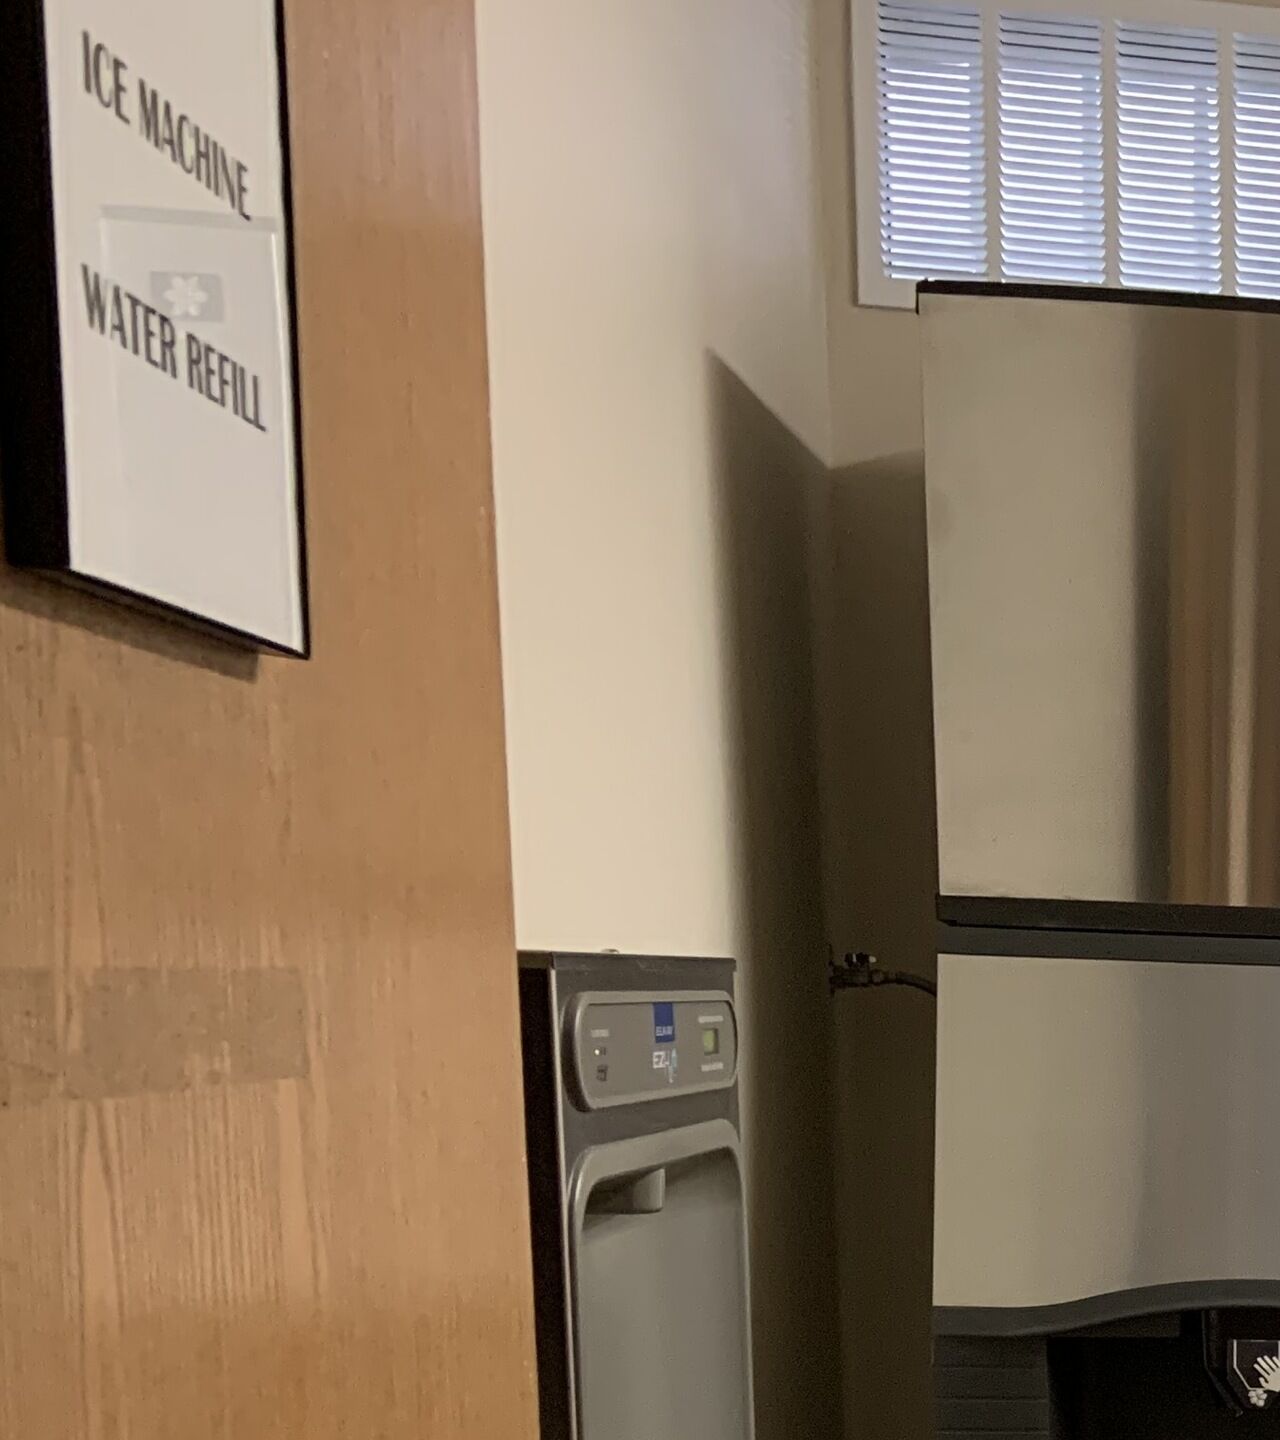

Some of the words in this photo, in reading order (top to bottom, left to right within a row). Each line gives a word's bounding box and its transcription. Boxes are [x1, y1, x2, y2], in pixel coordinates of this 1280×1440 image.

[81, 31, 130, 126] ICE
[138, 78, 252, 222] MACHINE
[80, 263, 177, 380] WATER
[186, 330, 267, 432] REFILL
